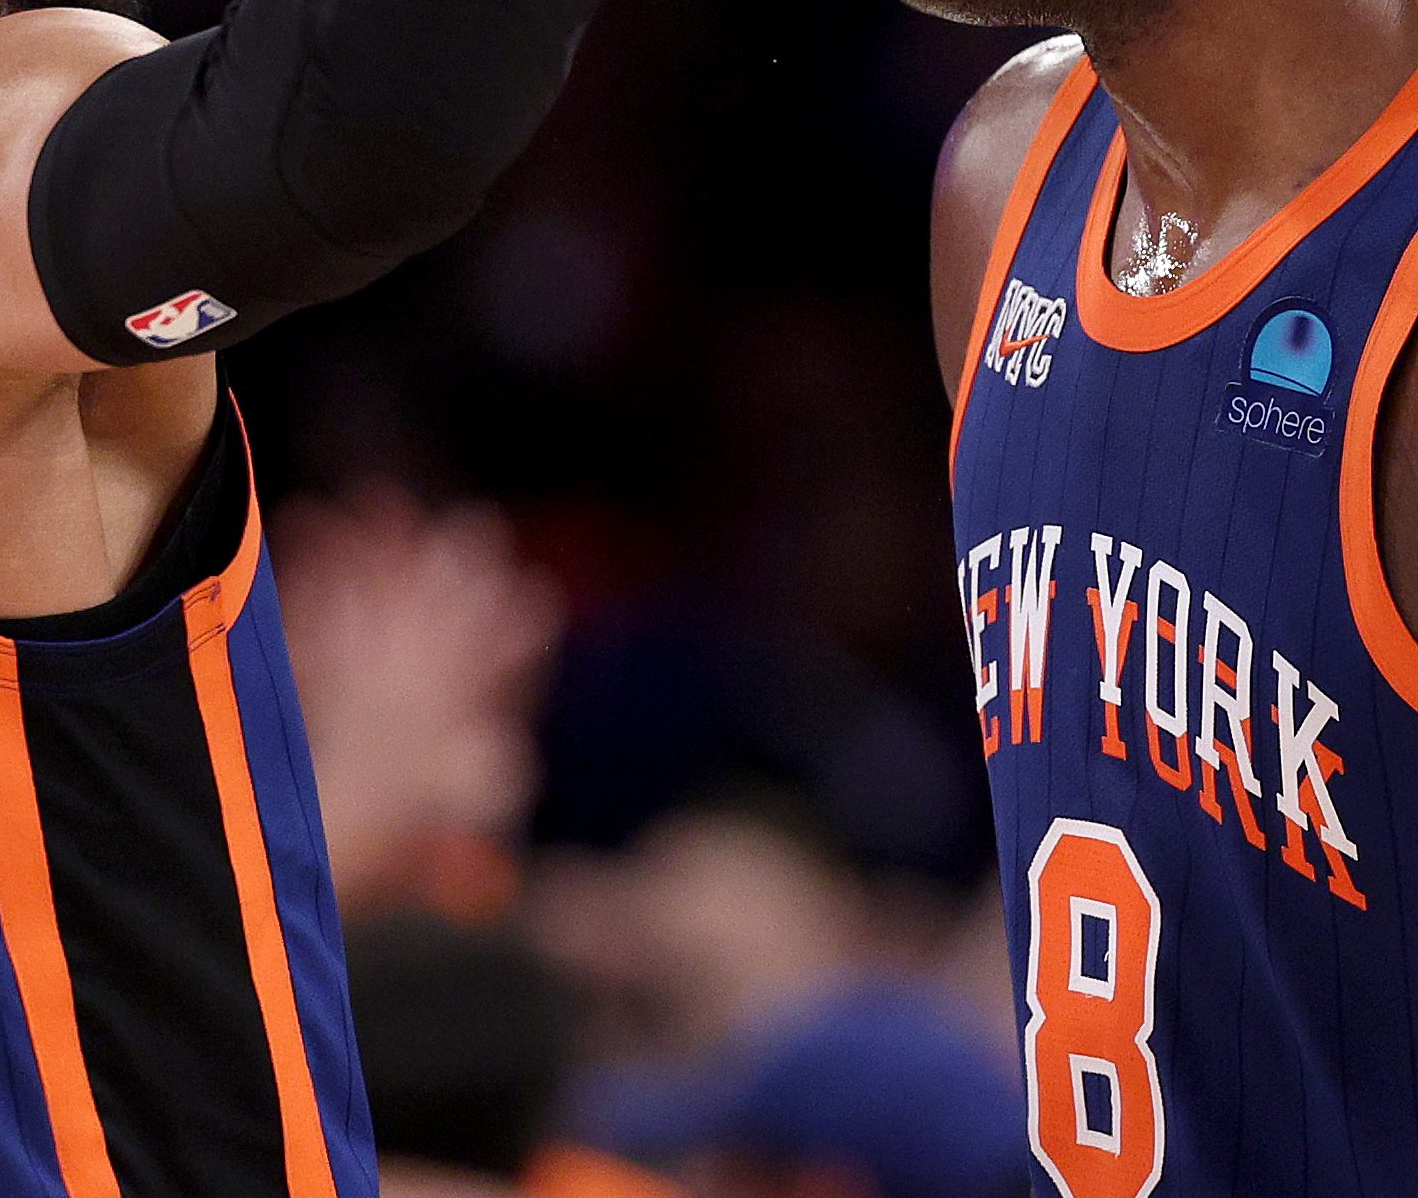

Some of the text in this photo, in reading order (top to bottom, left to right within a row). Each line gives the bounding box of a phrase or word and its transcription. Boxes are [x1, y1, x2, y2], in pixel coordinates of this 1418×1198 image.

[984, 277, 1067, 388] NYC
[1227, 396, 1326, 444] sphere
[958, 525, 1359, 862] EW YORK
[1025, 817, 1165, 1198] 8
